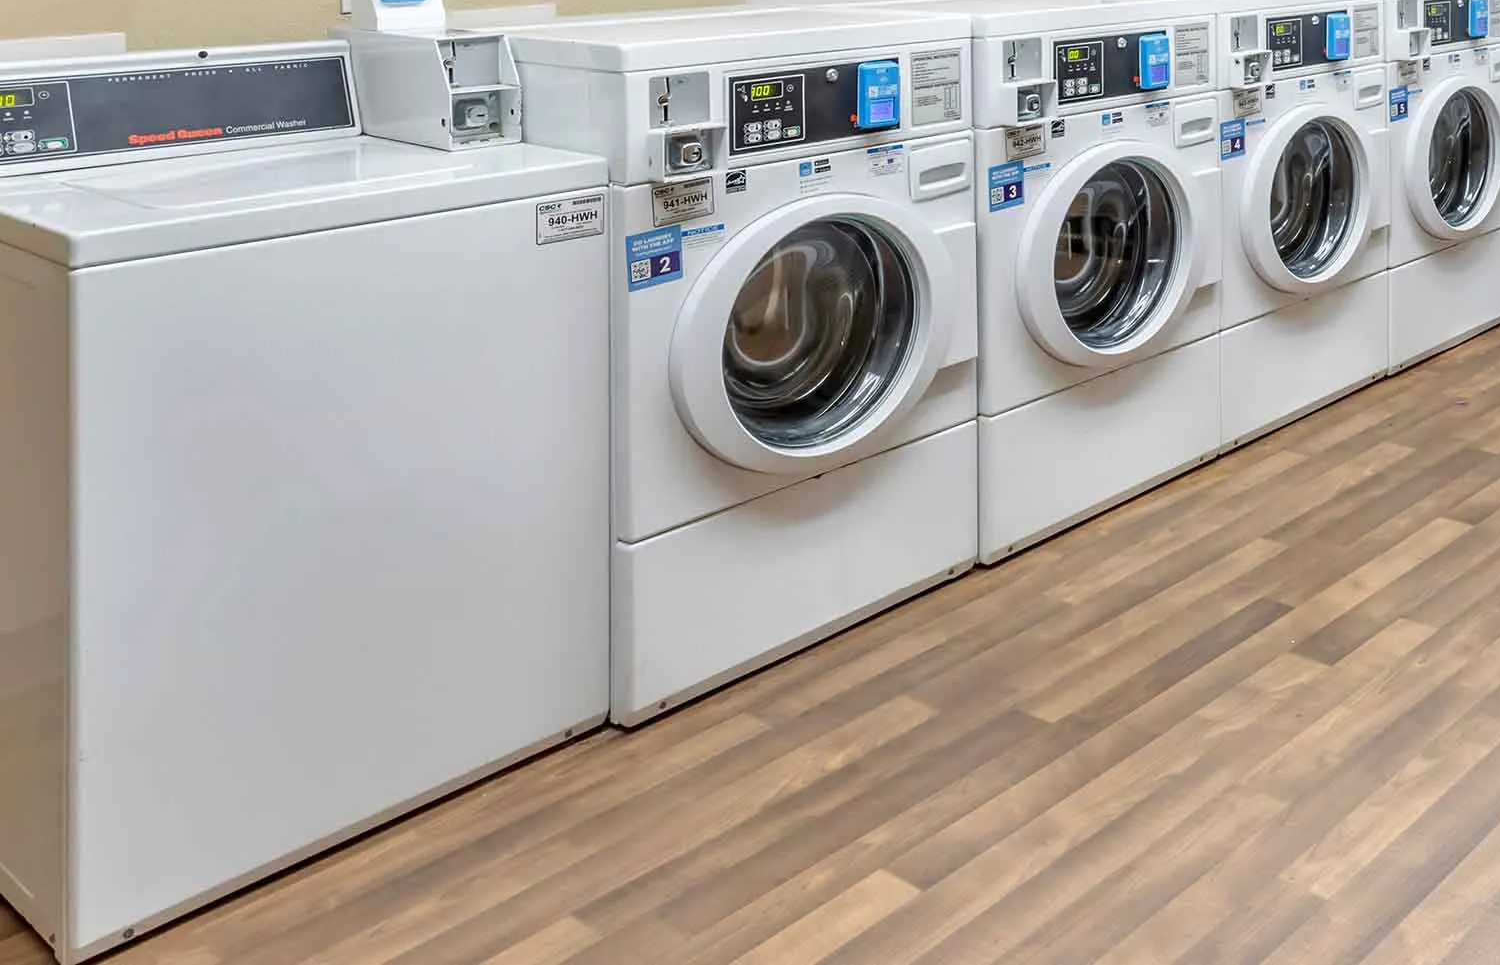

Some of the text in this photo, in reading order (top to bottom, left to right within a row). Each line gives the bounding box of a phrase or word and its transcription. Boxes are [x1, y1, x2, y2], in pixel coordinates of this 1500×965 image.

[1400, 103, 1405, 114] 5
[128, 119, 307, 145] Speed Queen Commercial Washer
[1234, 138, 1241, 149] 4
[1009, 185, 1017, 198] 3
[663, 192, 708, 210] 941-HWH
[548, 210, 598, 226] 940-HWH
[659, 256, 671, 274] 2
